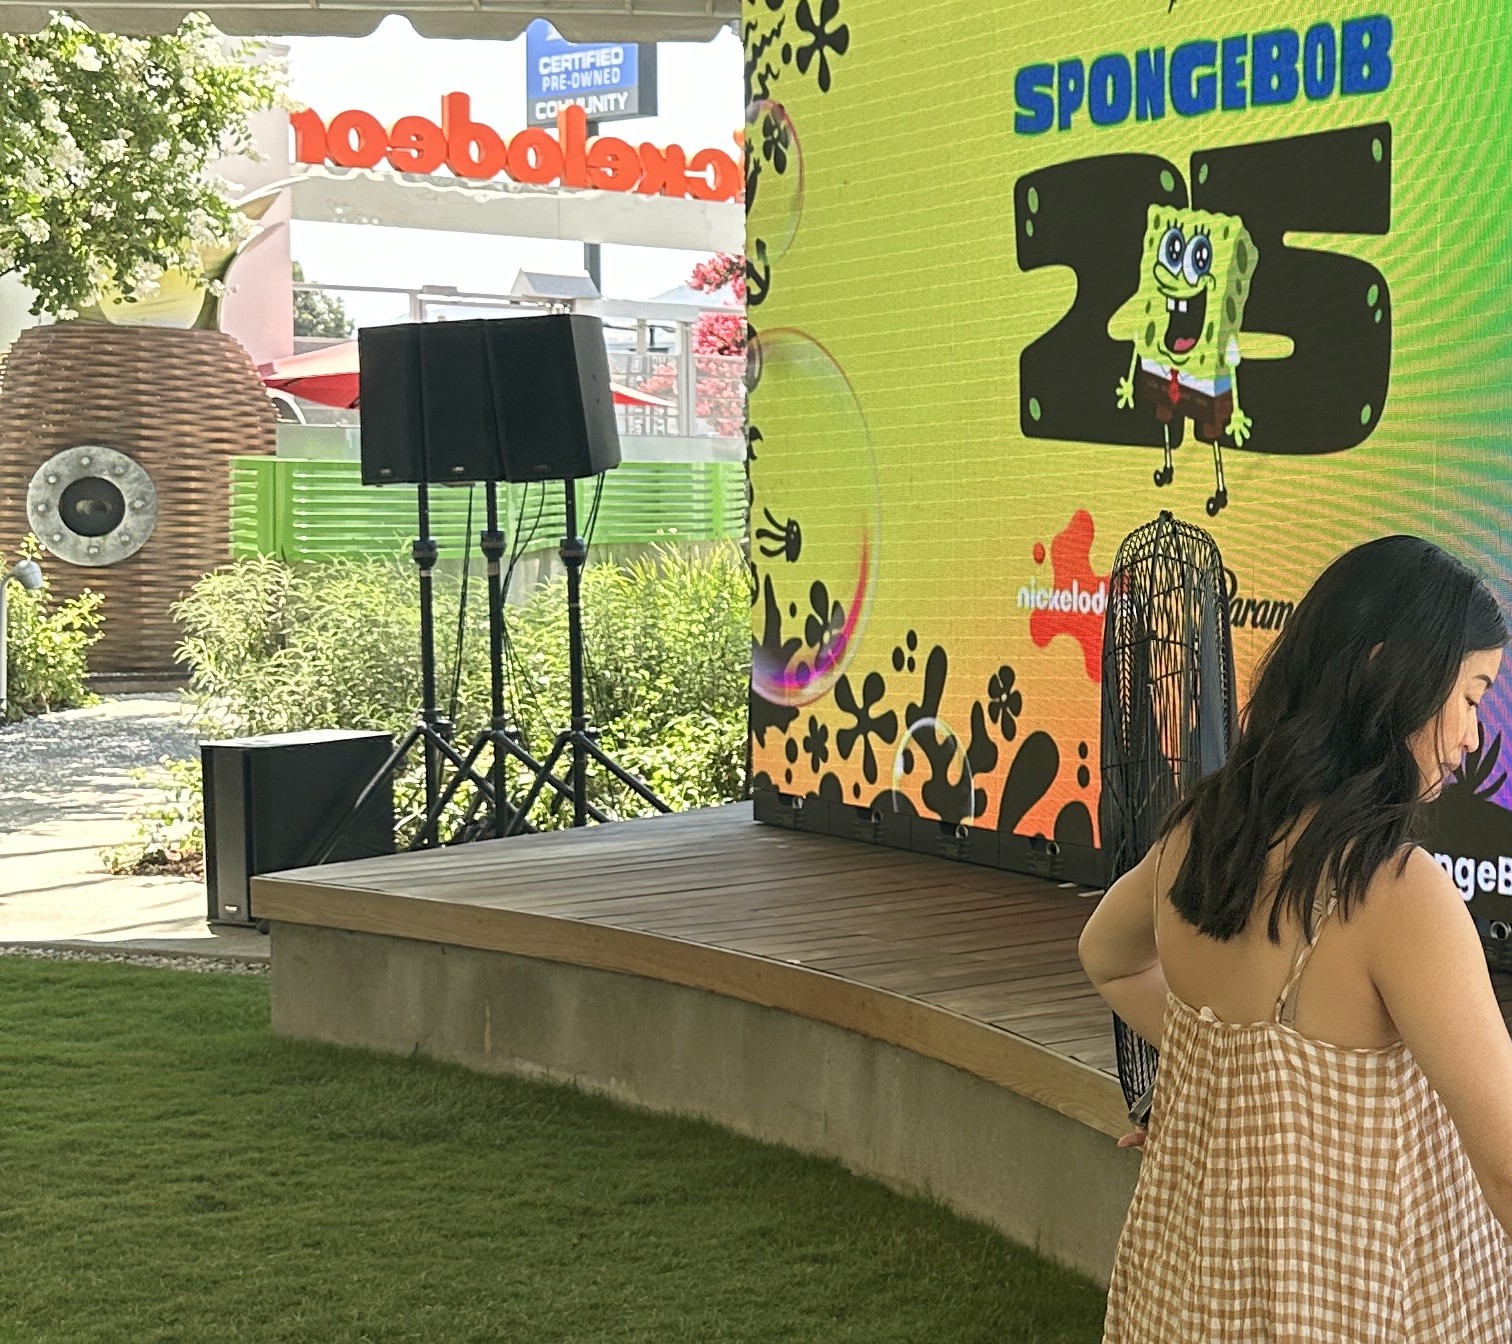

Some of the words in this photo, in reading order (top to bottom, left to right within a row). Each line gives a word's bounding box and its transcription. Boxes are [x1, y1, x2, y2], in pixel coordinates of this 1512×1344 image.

[538, 46, 624, 75] CERTIFIED
[541, 66, 621, 93] PRE-OWNED
[1014, 14, 1393, 135] SPONGEBOB
[1014, 121, 1393, 456] 25
[1017, 575, 1136, 620] nickelod
